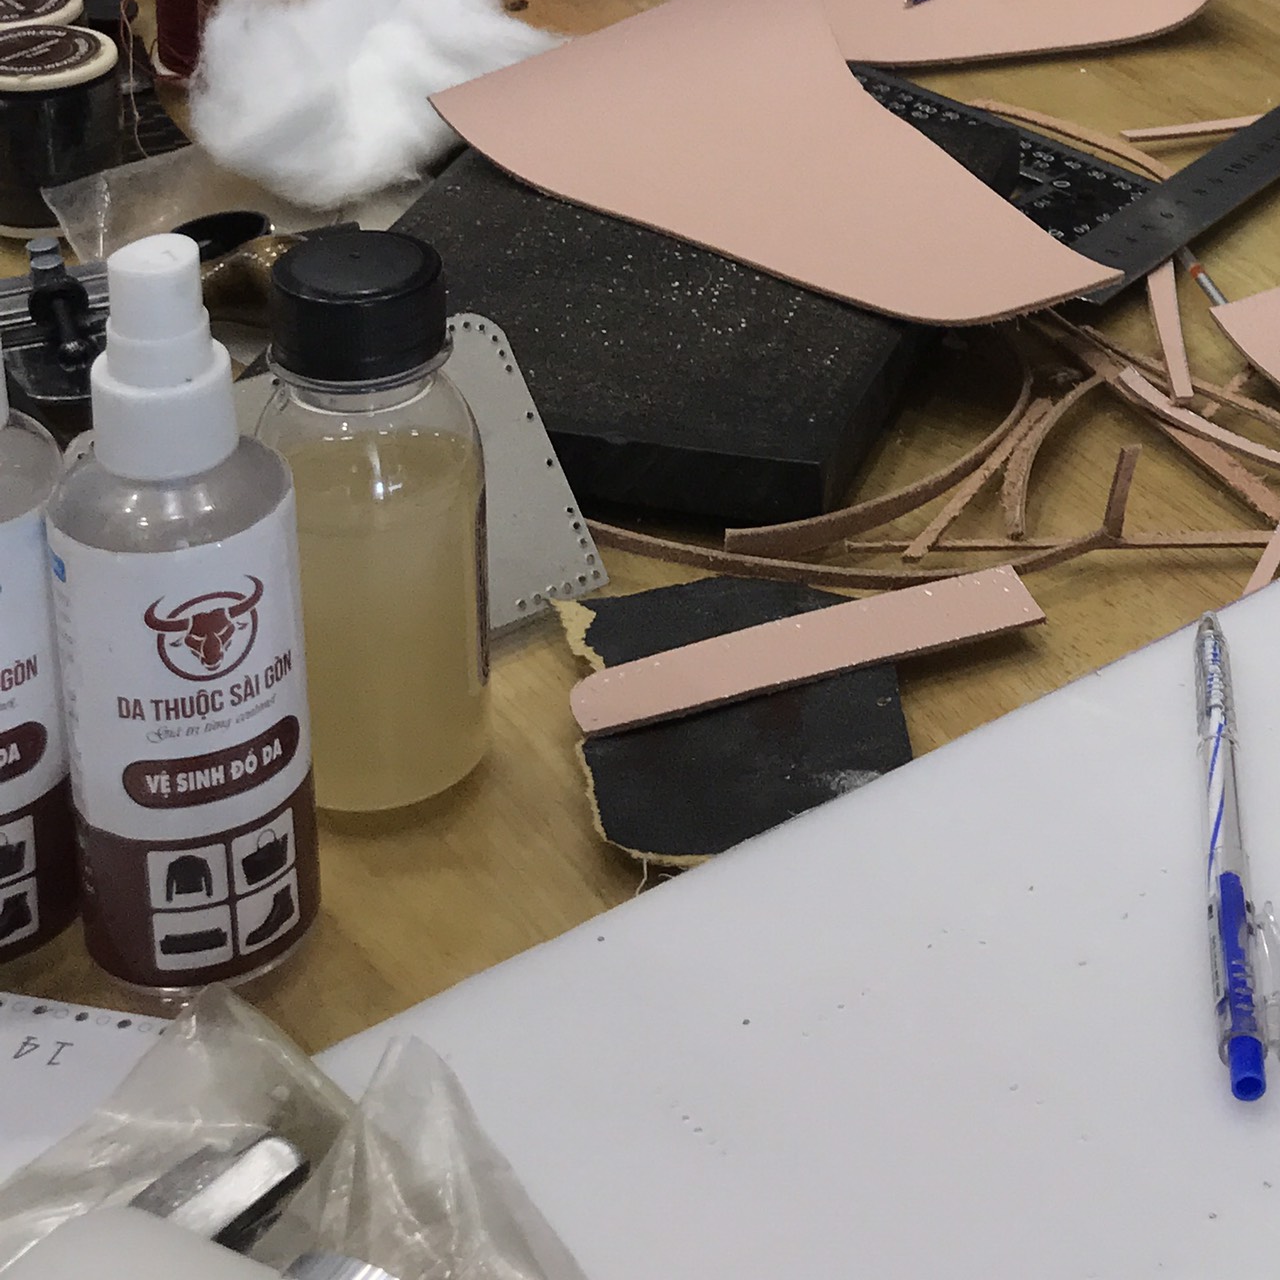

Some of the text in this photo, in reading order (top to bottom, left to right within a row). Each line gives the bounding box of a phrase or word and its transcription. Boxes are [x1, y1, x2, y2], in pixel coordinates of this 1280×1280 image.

[117, 649, 293, 721] DA THUỘC SÀI GÒN
[145, 770, 171, 799] VỆ
[176, 764, 226, 794] SINH
[262, 737, 284, 766] DA
